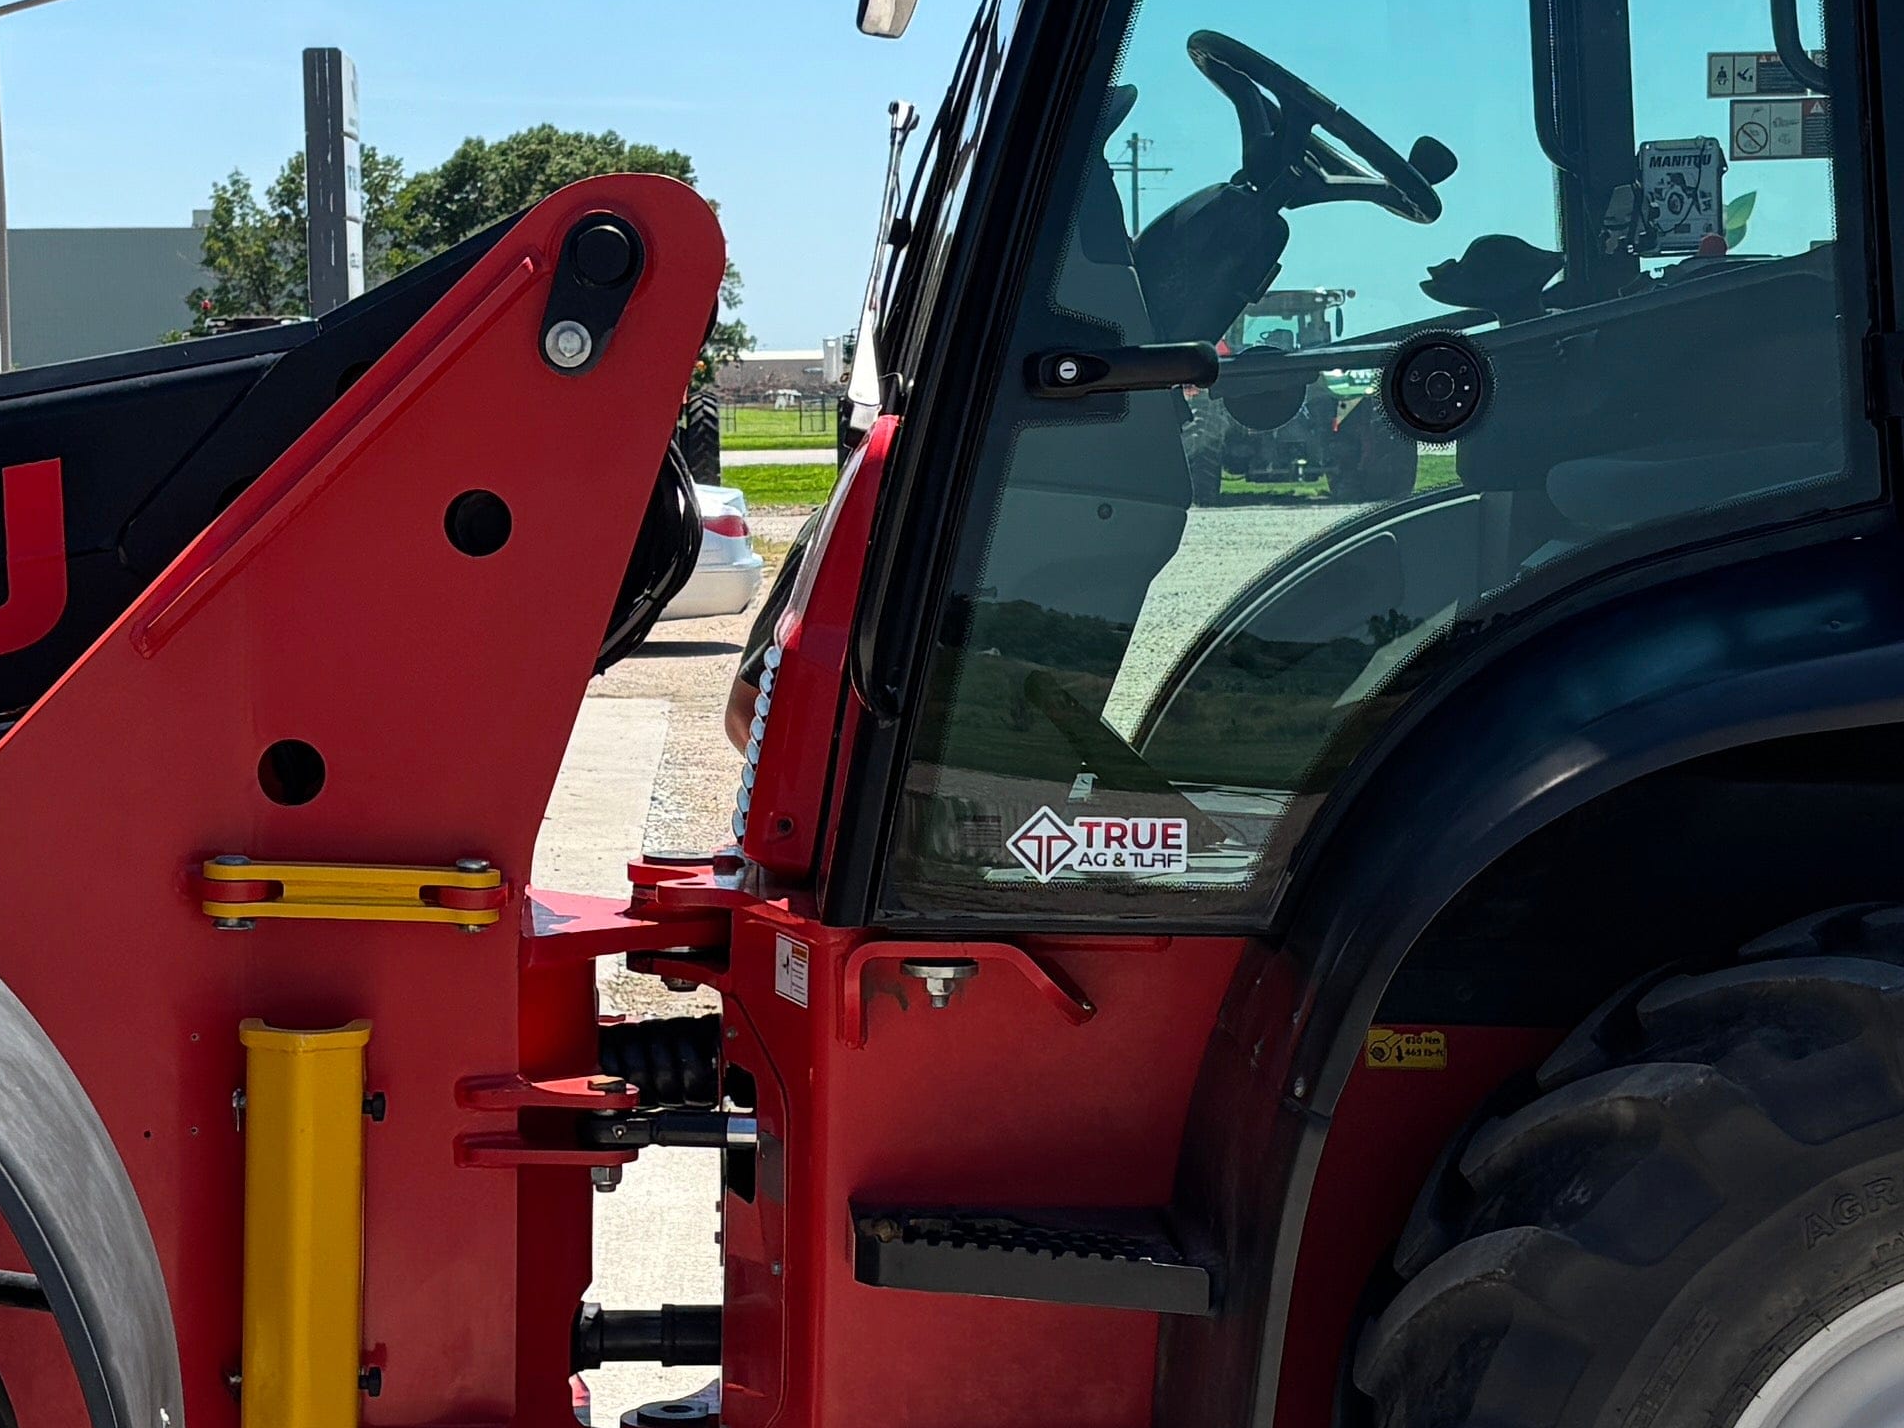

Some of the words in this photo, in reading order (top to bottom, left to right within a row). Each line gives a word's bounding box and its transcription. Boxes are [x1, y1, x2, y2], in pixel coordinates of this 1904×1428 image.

[1650, 155, 1712, 167] MANITOU
[1079, 822, 1182, 850] TRUE
[1078, 852, 1107, 867] AG
[1113, 853, 1126, 867] &
[1130, 852, 1182, 868] TURF
